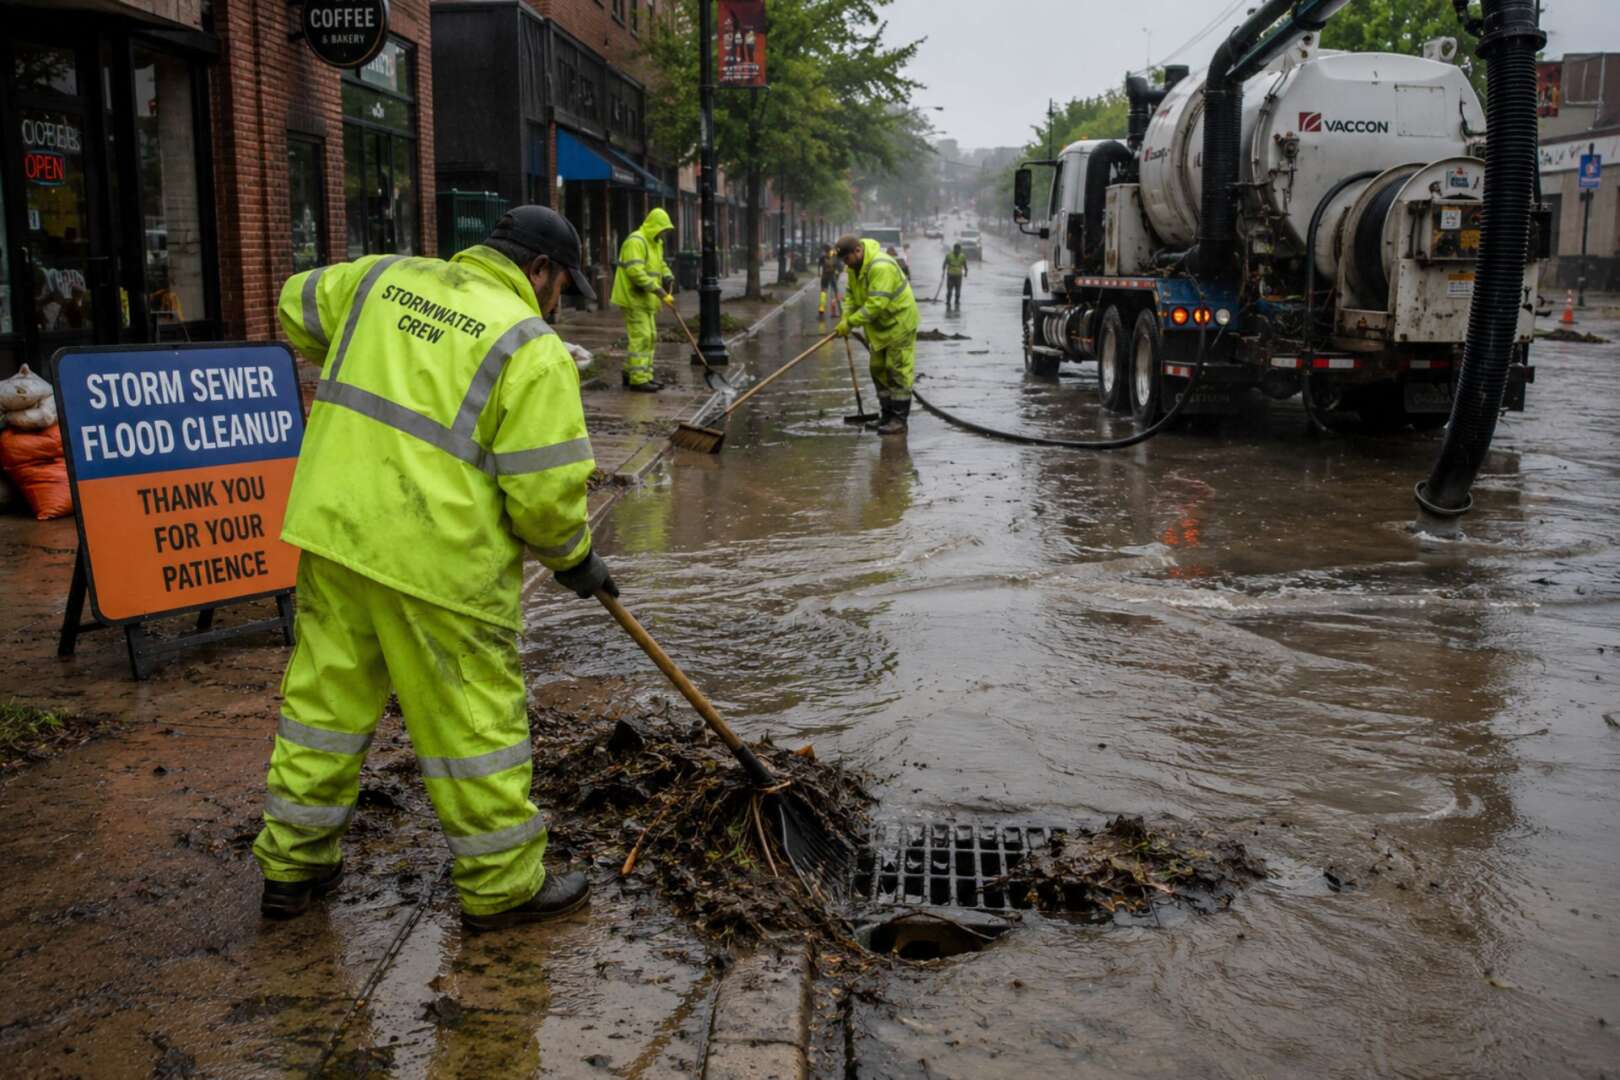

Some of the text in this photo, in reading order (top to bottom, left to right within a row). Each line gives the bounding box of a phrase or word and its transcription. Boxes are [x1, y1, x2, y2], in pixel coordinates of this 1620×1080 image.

[310, 7, 375, 28] COFFEE
[321, 33, 365, 44] & BAKERY
[1324, 120, 1389, 133] VACCON
[24, 154, 65, 180] OPEN
[381, 284, 486, 339] STORMWATER
[397, 314, 445, 344] CREW
[87, 366, 277, 409] STORM SEWER
[81, 410, 293, 461] FLOOD CLEANUP
[137, 475, 265, 515] THANK YOU
[154, 513, 265, 553] FOR YOUR
[162, 550, 269, 593] PATIENCE
